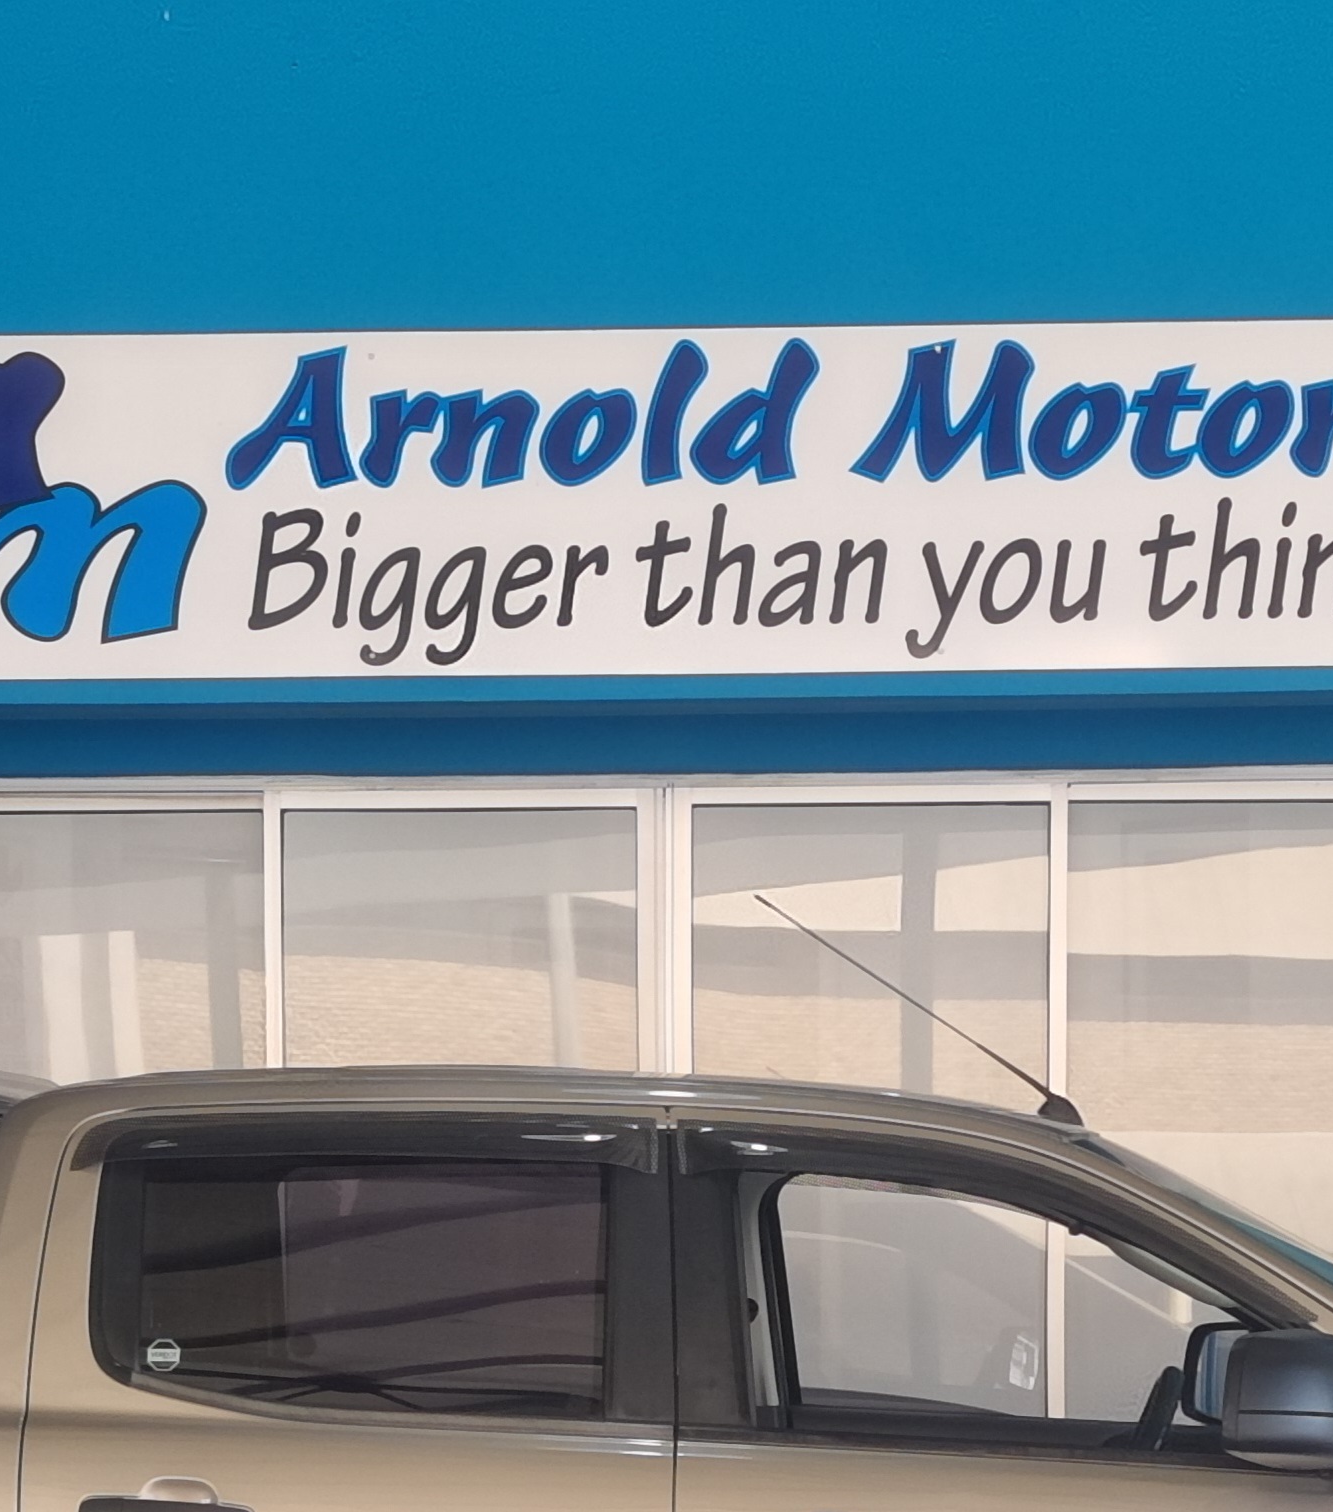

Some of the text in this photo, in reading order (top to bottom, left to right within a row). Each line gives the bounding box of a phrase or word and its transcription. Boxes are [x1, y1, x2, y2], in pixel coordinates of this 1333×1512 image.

[226, 338, 819, 489] Arnold
[247, 508, 608, 666] Bigger
[637, 503, 887, 628] than
[905, 539, 1107, 659] you
